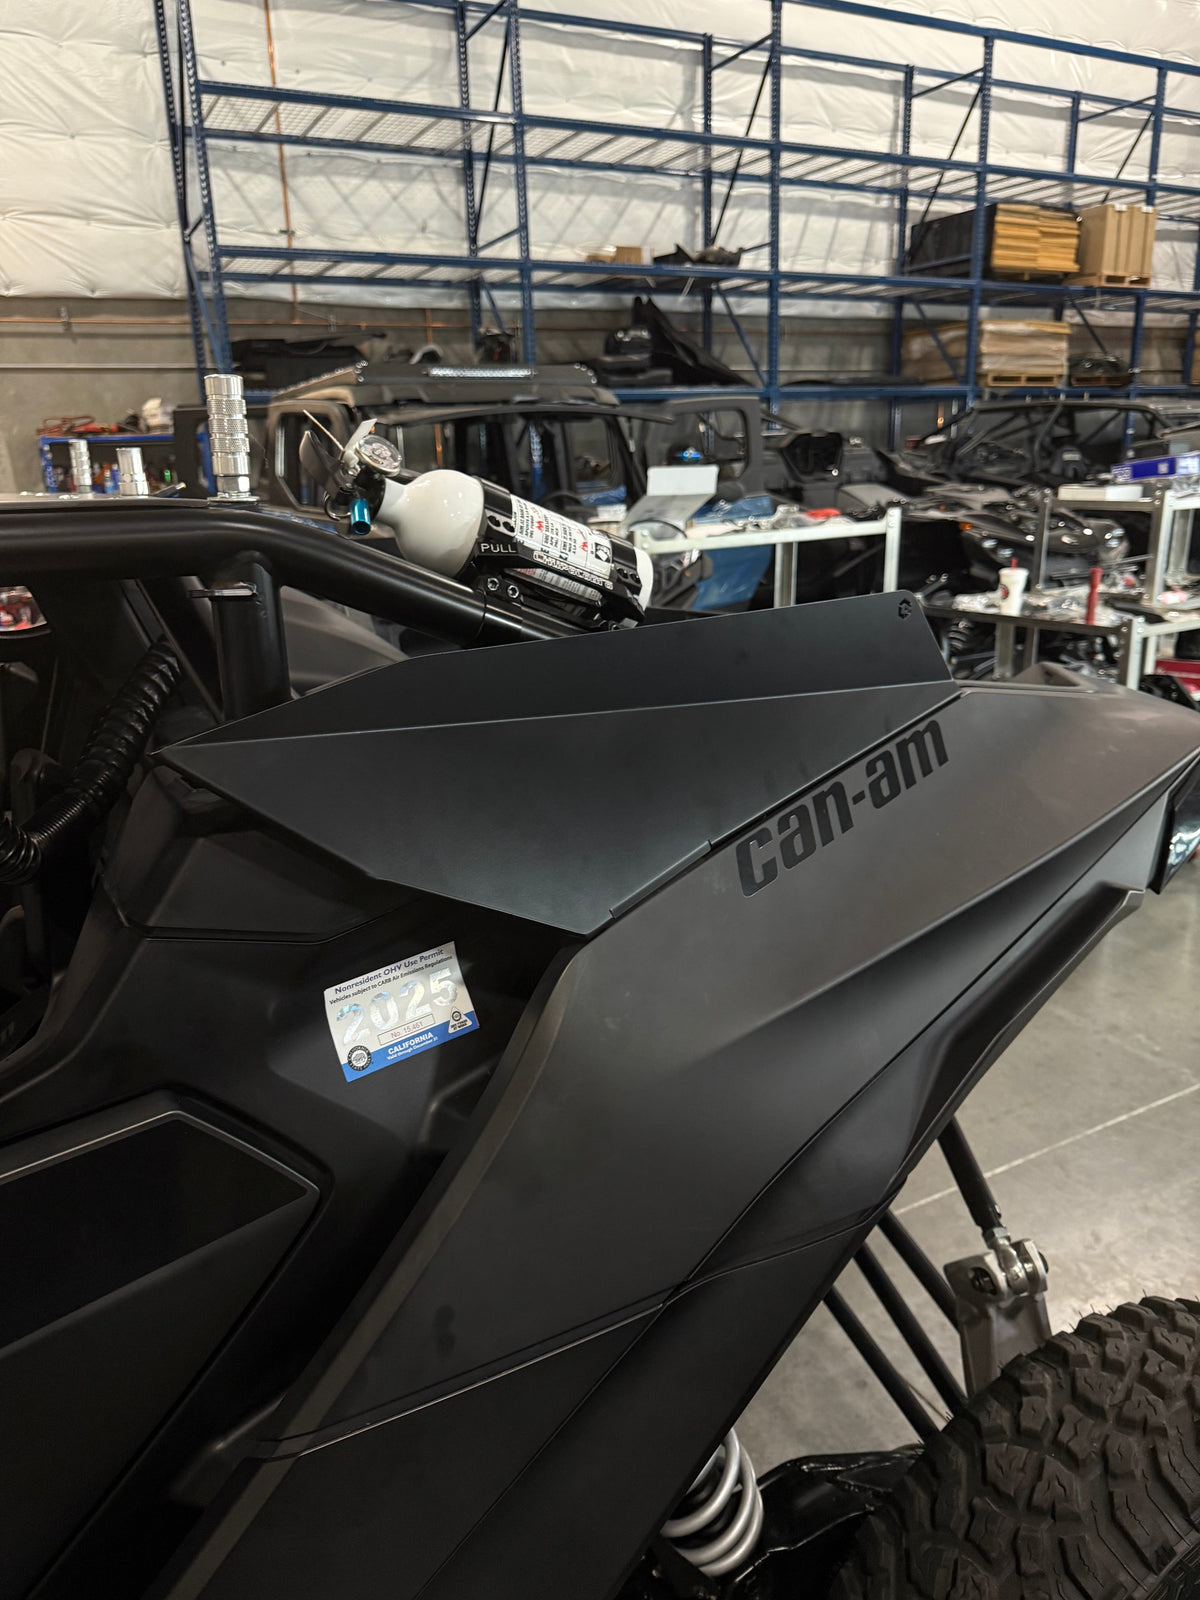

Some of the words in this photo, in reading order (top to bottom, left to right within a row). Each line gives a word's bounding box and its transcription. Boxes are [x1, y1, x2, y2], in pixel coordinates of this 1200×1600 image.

[480, 543, 516, 553] PULL
[736, 719, 949, 897] can-am
[329, 993, 351, 1005] Vehicles
[352, 986, 371, 998] subject
[378, 977, 391, 987] CARB
[400, 966, 424, 979] Emissions
[424, 955, 453, 970] Regulations
[334, 972, 382, 994] Nonresident
[383, 965, 402, 976] OHV
[404, 959, 418, 968] Use
[419, 949, 444, 963] Permit
[336, 967, 458, 1045] 2025
[388, 1032, 434, 1055] CALIFORNIA
